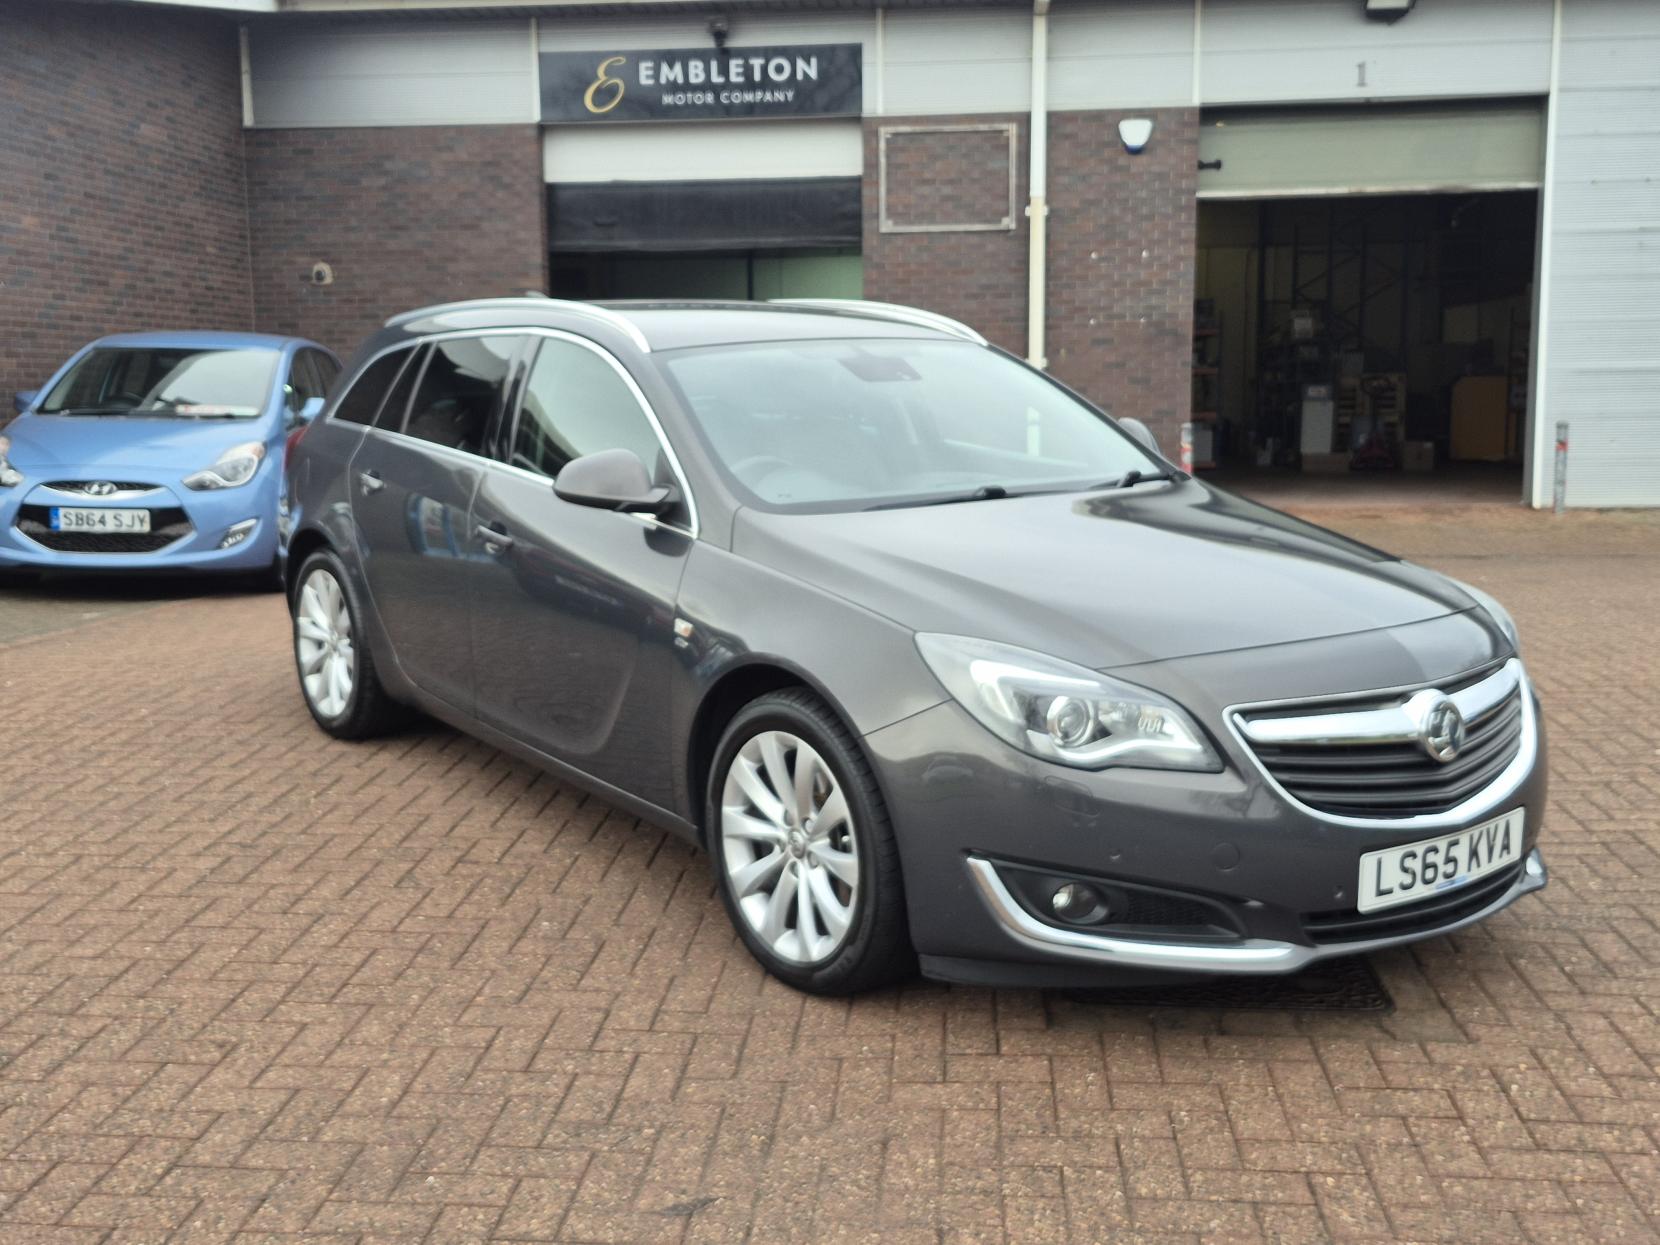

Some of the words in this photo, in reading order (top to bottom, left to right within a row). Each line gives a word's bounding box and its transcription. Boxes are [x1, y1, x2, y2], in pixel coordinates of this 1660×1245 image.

[639, 56, 818, 85] EMBLETON
[662, 92, 714, 105] MOTOR
[720, 89, 794, 104] COMPANY
[63, 510, 106, 527] SB64
[113, 511, 146, 527] SJY
[1375, 839, 1460, 897] LS65
[1467, 819, 1511, 873] KVA
